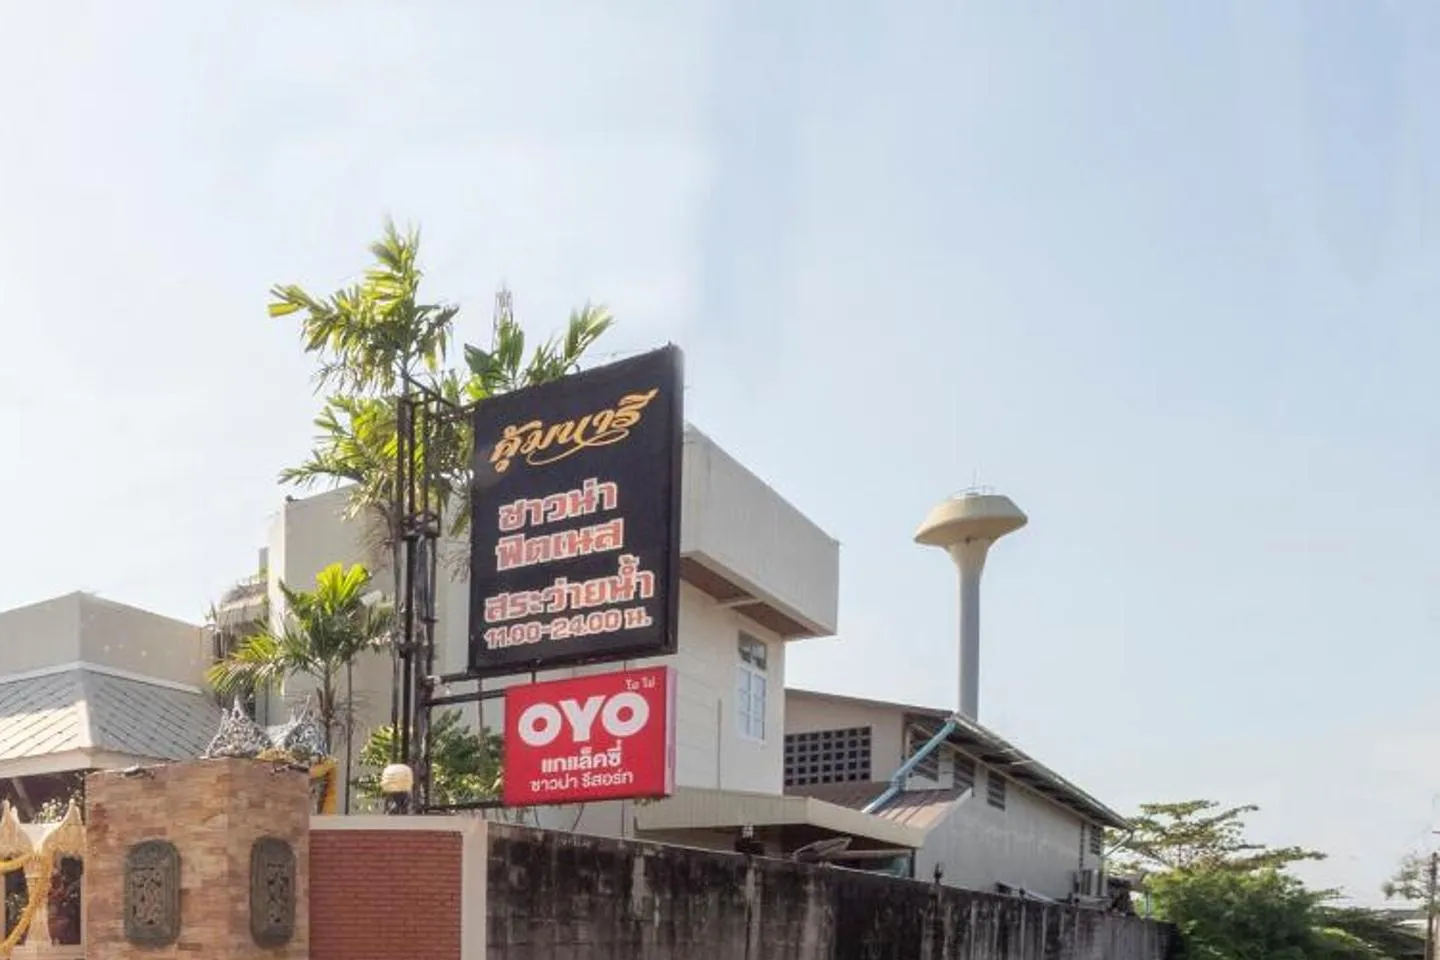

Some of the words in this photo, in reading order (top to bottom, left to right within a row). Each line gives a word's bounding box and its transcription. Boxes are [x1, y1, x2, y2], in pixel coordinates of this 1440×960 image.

[498, 477, 618, 532] ซาวน่า
[496, 518, 625, 571] ฟิตเนส
[484, 554, 655, 623] สระว่ายน้ำ
[484, 610, 622, 649] 11.00-24.00
[518, 691, 650, 747] OYO
